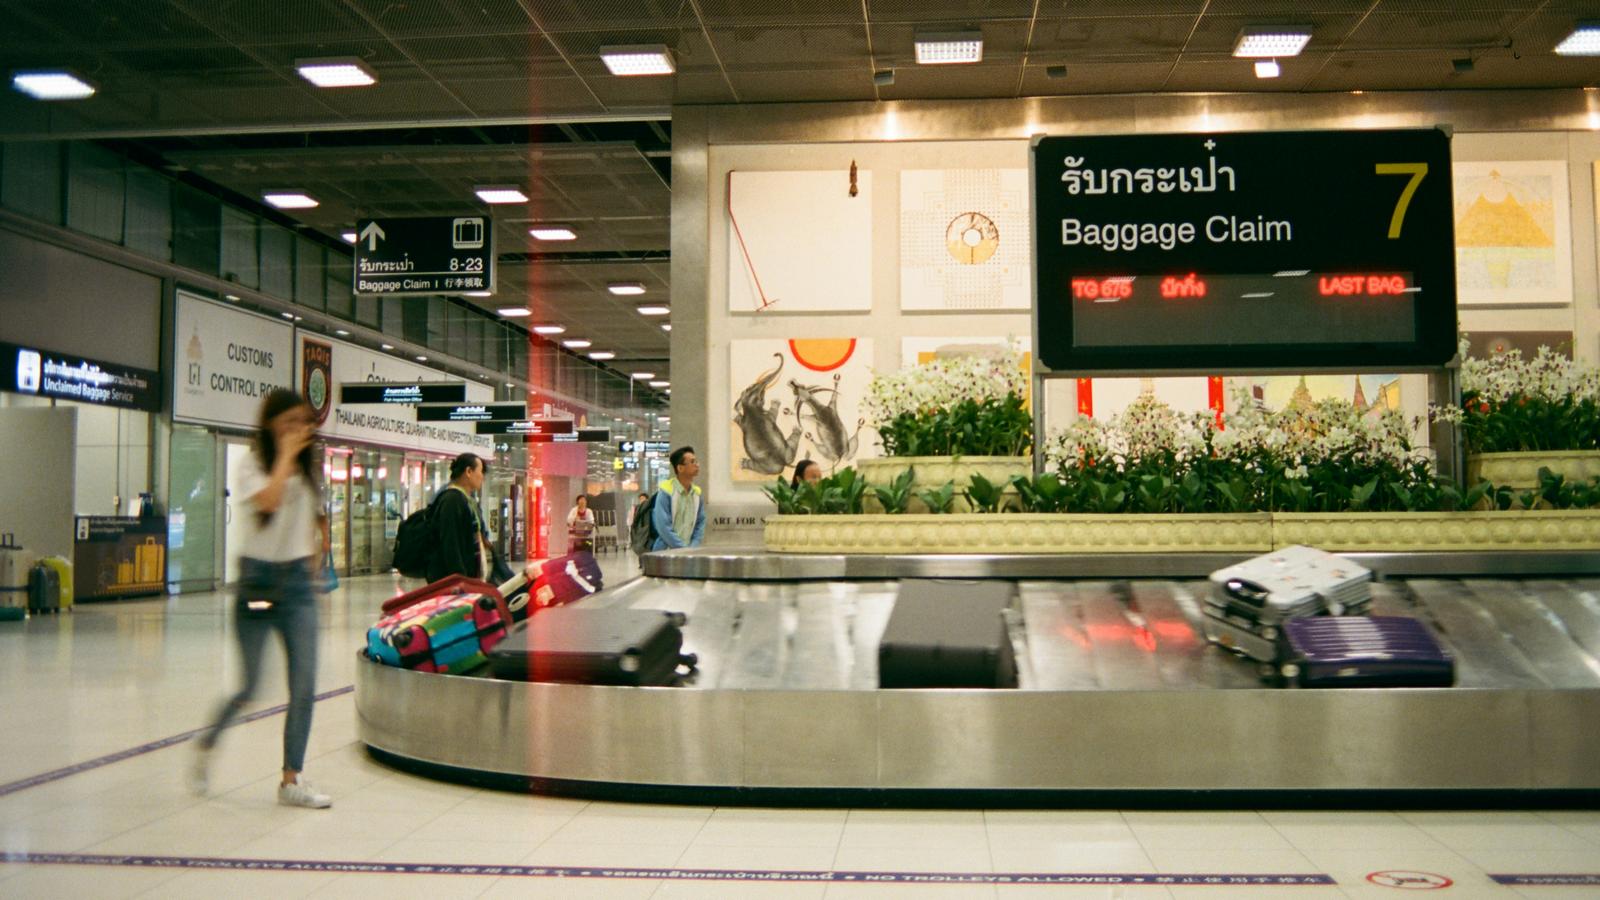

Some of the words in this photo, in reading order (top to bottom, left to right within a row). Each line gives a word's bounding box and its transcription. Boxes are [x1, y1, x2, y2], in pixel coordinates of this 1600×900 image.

[1061, 139, 1236, 195] รับกระเป๋า
[1375, 162, 1429, 240] 7
[1061, 218, 1196, 251] Baggage
[1204, 215, 1293, 243] Claim
[359, 252, 414, 272] รับกระเป๋า
[450, 257, 483, 271] 8-23
[359, 279, 401, 292] Baggage
[403, 279, 431, 289] Claim
[1072, 279, 1099, 298] TG
[1100, 278, 1132, 298] 675
[1318, 275, 1365, 296] LAST
[1366, 275, 1406, 295] BAG
[227, 342, 274, 369] CUSTOMS
[44, 377, 82, 395] Unclaimed
[82, 384, 111, 401] Baggage
[111, 388, 134, 402] Service
[210, 373, 258, 398] CONTROL
[335, 408, 366, 427] THAILAND
[367, 415, 405, 434] AGRICULTURE
[405, 421, 437, 440] QUARANTINE
[713, 516, 731, 525] ART
[736, 516, 755, 525] FOR
[288, 863, 387, 871] ALLOWED
